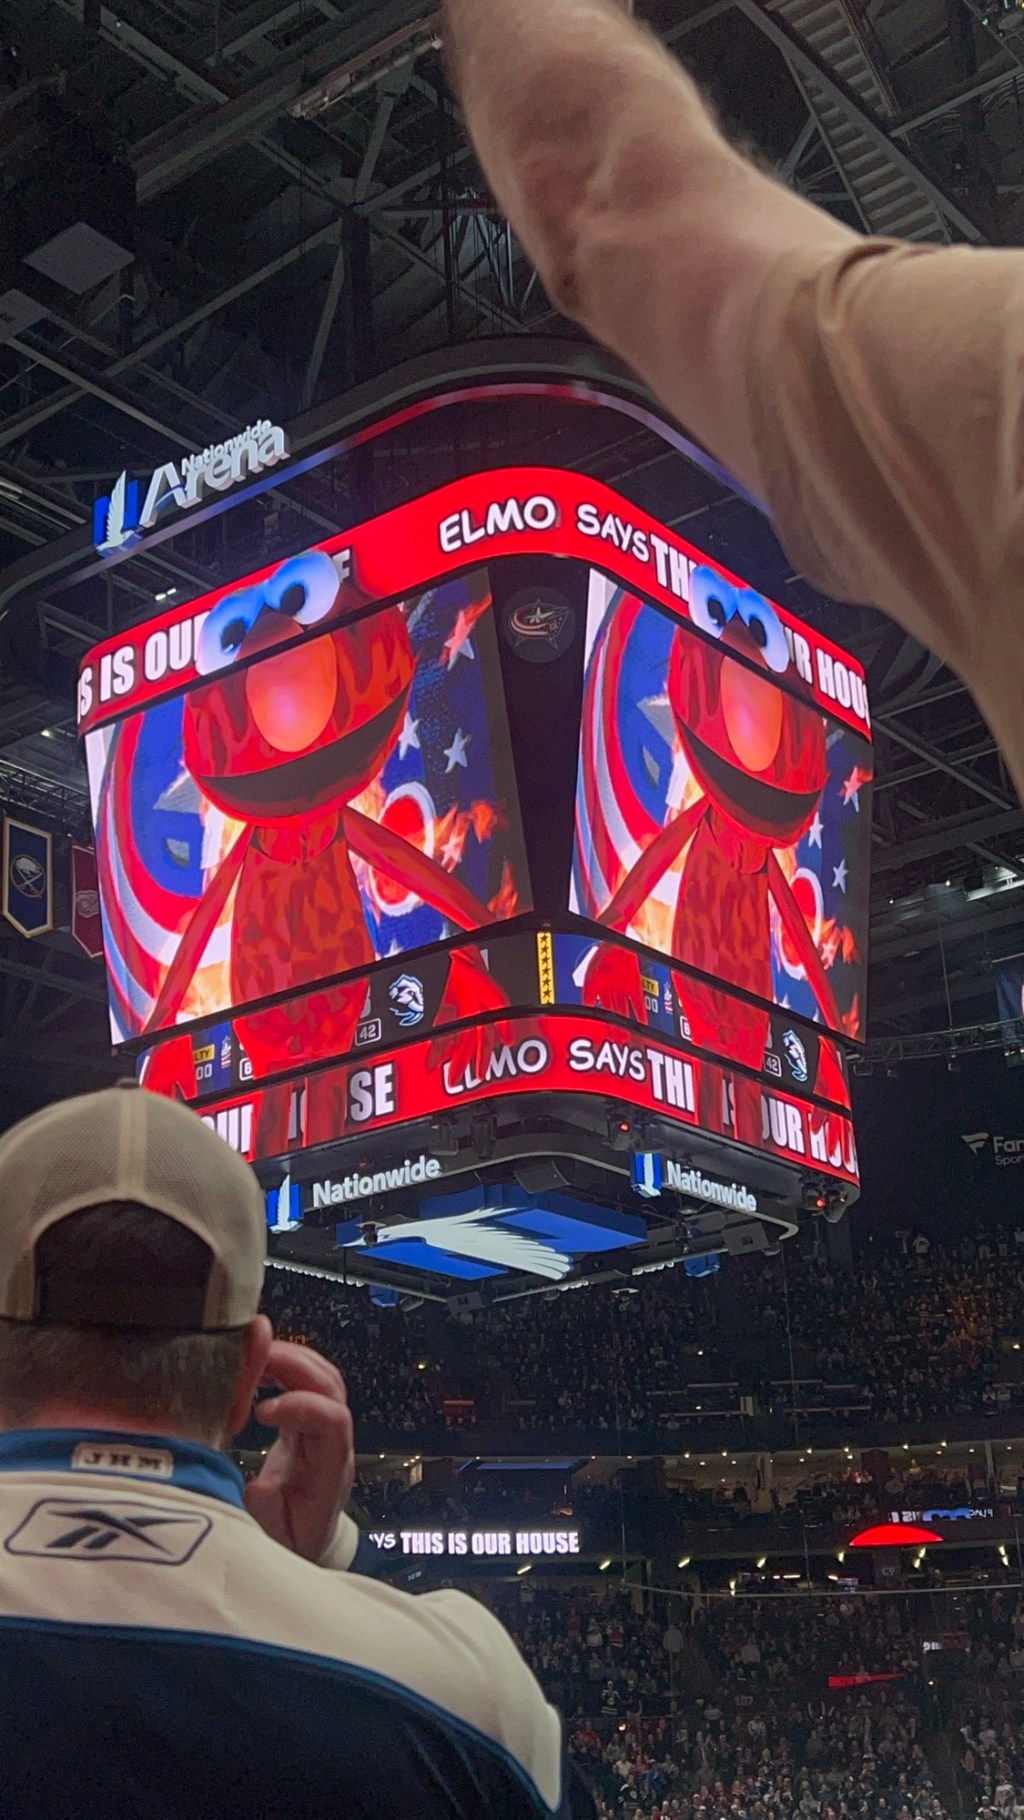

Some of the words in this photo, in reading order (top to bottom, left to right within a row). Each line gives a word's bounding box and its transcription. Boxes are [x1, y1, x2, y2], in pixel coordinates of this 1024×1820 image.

[181, 419, 272, 476] Nationwide
[139, 426, 289, 527] Arena
[439, 495, 557, 552] ELMO
[577, 504, 649, 562] SAYS
[650, 533, 698, 603] TH
[816, 647, 871, 729] HOU
[100, 645, 135, 702] IS
[143, 610, 211, 681] OU
[359, 1024, 377, 1040] 42
[569, 1039, 645, 1081] SAYS
[766, 1056, 778, 1072] 42
[313, 1155, 440, 1208] Nationwide
[666, 1160, 757, 1212] Nationwide
[400, 1532, 444, 1554] THIS
[448, 1532, 467, 1555] IS
[471, 1532, 511, 1555] OUR
[516, 1532, 580, 1554] HOUSE
